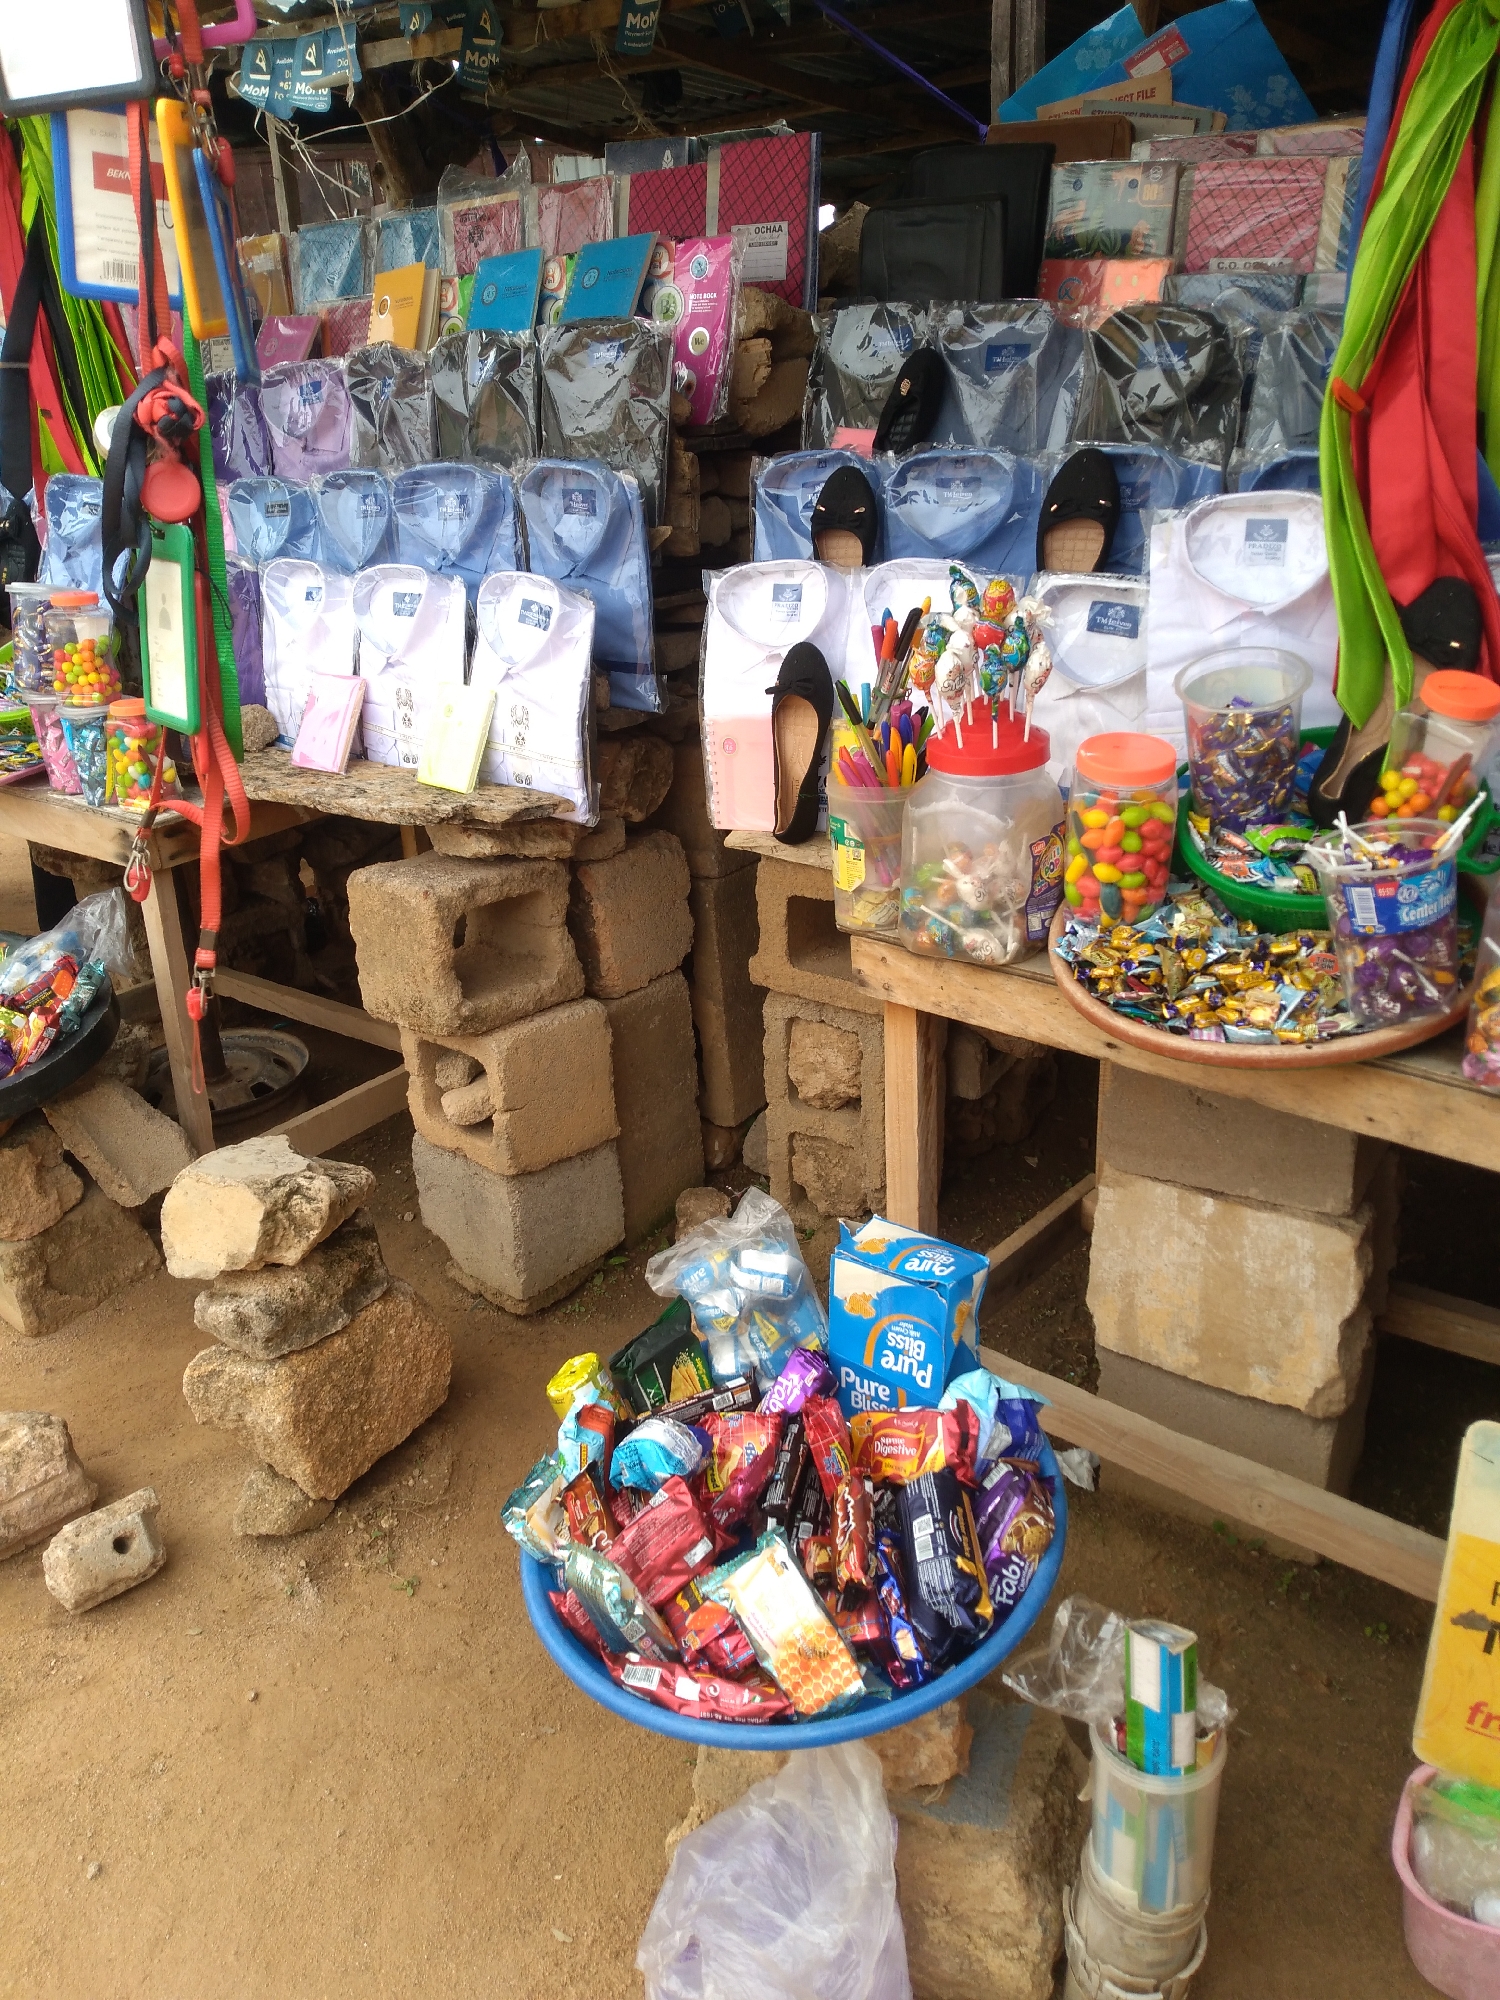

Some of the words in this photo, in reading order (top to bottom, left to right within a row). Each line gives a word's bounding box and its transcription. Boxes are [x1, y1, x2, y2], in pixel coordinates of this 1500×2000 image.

[1136, 86, 1157, 99] FILE
[754, 224, 783, 235] OCHAA
[1402, 901, 1439, 922] Center
[904, 1257, 957, 1277] Pure
[917, 1250, 955, 1265] Bliss
[886, 1331, 926, 1361] Bliss
[880, 1349, 933, 1389] Pure
[840, 1366, 890, 1401] Pure
[874, 1440, 918, 1457] Digestive
[994, 1553, 1026, 1606] Fab!
